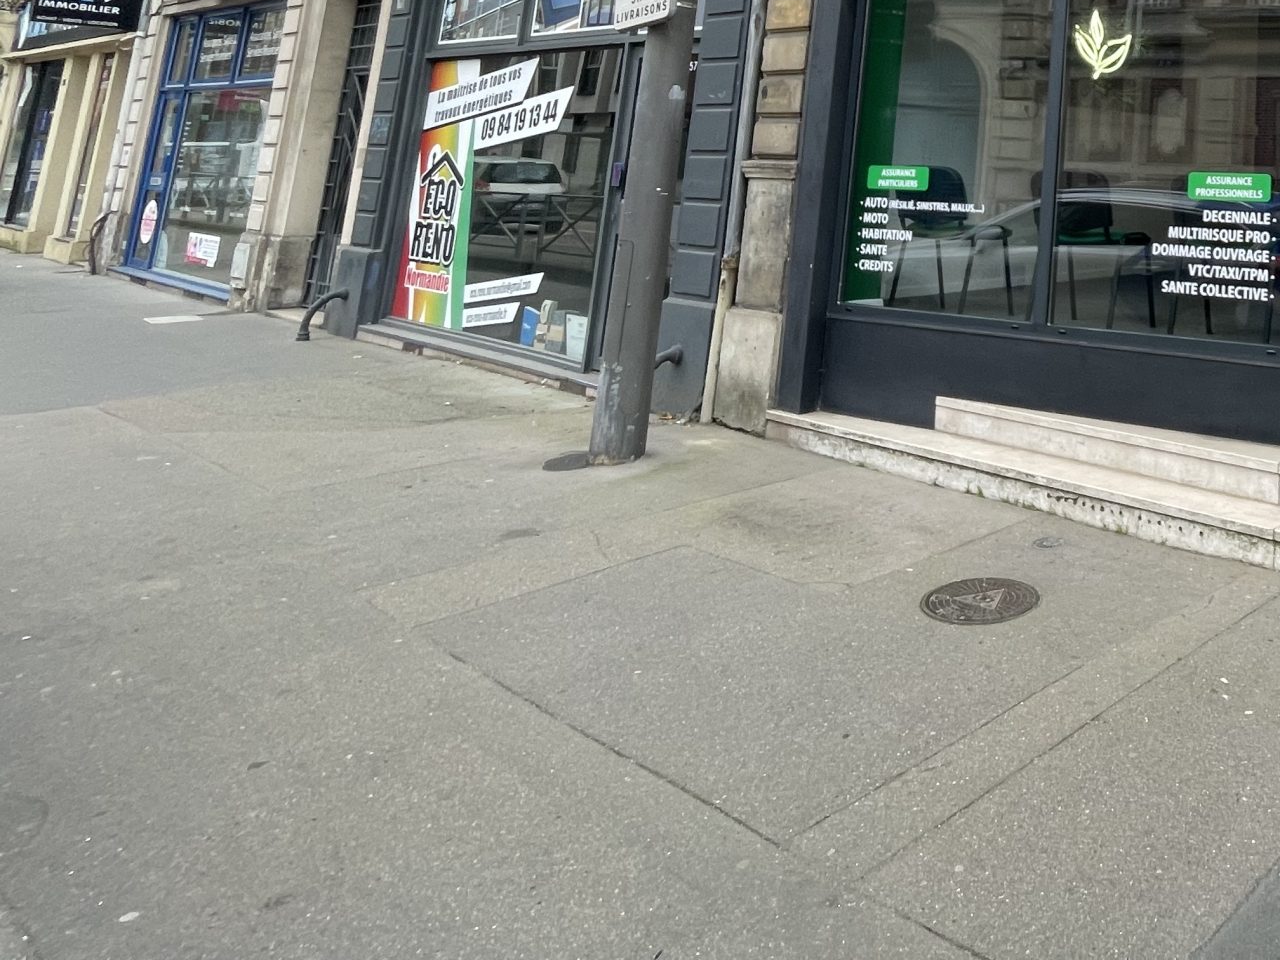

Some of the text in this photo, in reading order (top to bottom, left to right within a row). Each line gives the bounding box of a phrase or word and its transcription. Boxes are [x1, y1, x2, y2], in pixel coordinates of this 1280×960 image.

[38, 0, 120, 14] IMMOBILIER
[616, 0, 668, 23] LIVRAISONS
[438, 91, 446, 104] La
[478, 78, 488, 91] de
[489, 72, 507, 87] tous
[508, 67, 522, 82] vos
[434, 105, 461, 123] travaux
[481, 99, 558, 141] 09 84 19 13 44
[881, 168, 916, 177] ASSURANCE
[1206, 176, 1253, 186] ASSURANCE
[877, 179, 918, 188] PARTICULIERS
[423, 178, 457, 217] ECO
[1195, 188, 1263, 199] PROFESSIONNELS
[864, 197, 888, 208] AUTO
[863, 212, 889, 224] MOTO
[1202, 209, 1271, 225] DECENNALE
[410, 221, 456, 264] RENO
[861, 228, 913, 241] HABITATION
[1168, 226, 1270, 244] MULTIRISQUE PRO
[860, 243, 887, 255] SANTE
[1152, 243, 1270, 262] DOMMAGE OUVRAGE
[859, 259, 893, 272] CREDITS
[1188, 264, 1269, 282] VTC/TAXI/TPM
[406, 268, 450, 292] Normandie
[1161, 280, 1269, 301] SANTE COLLECTIVE
